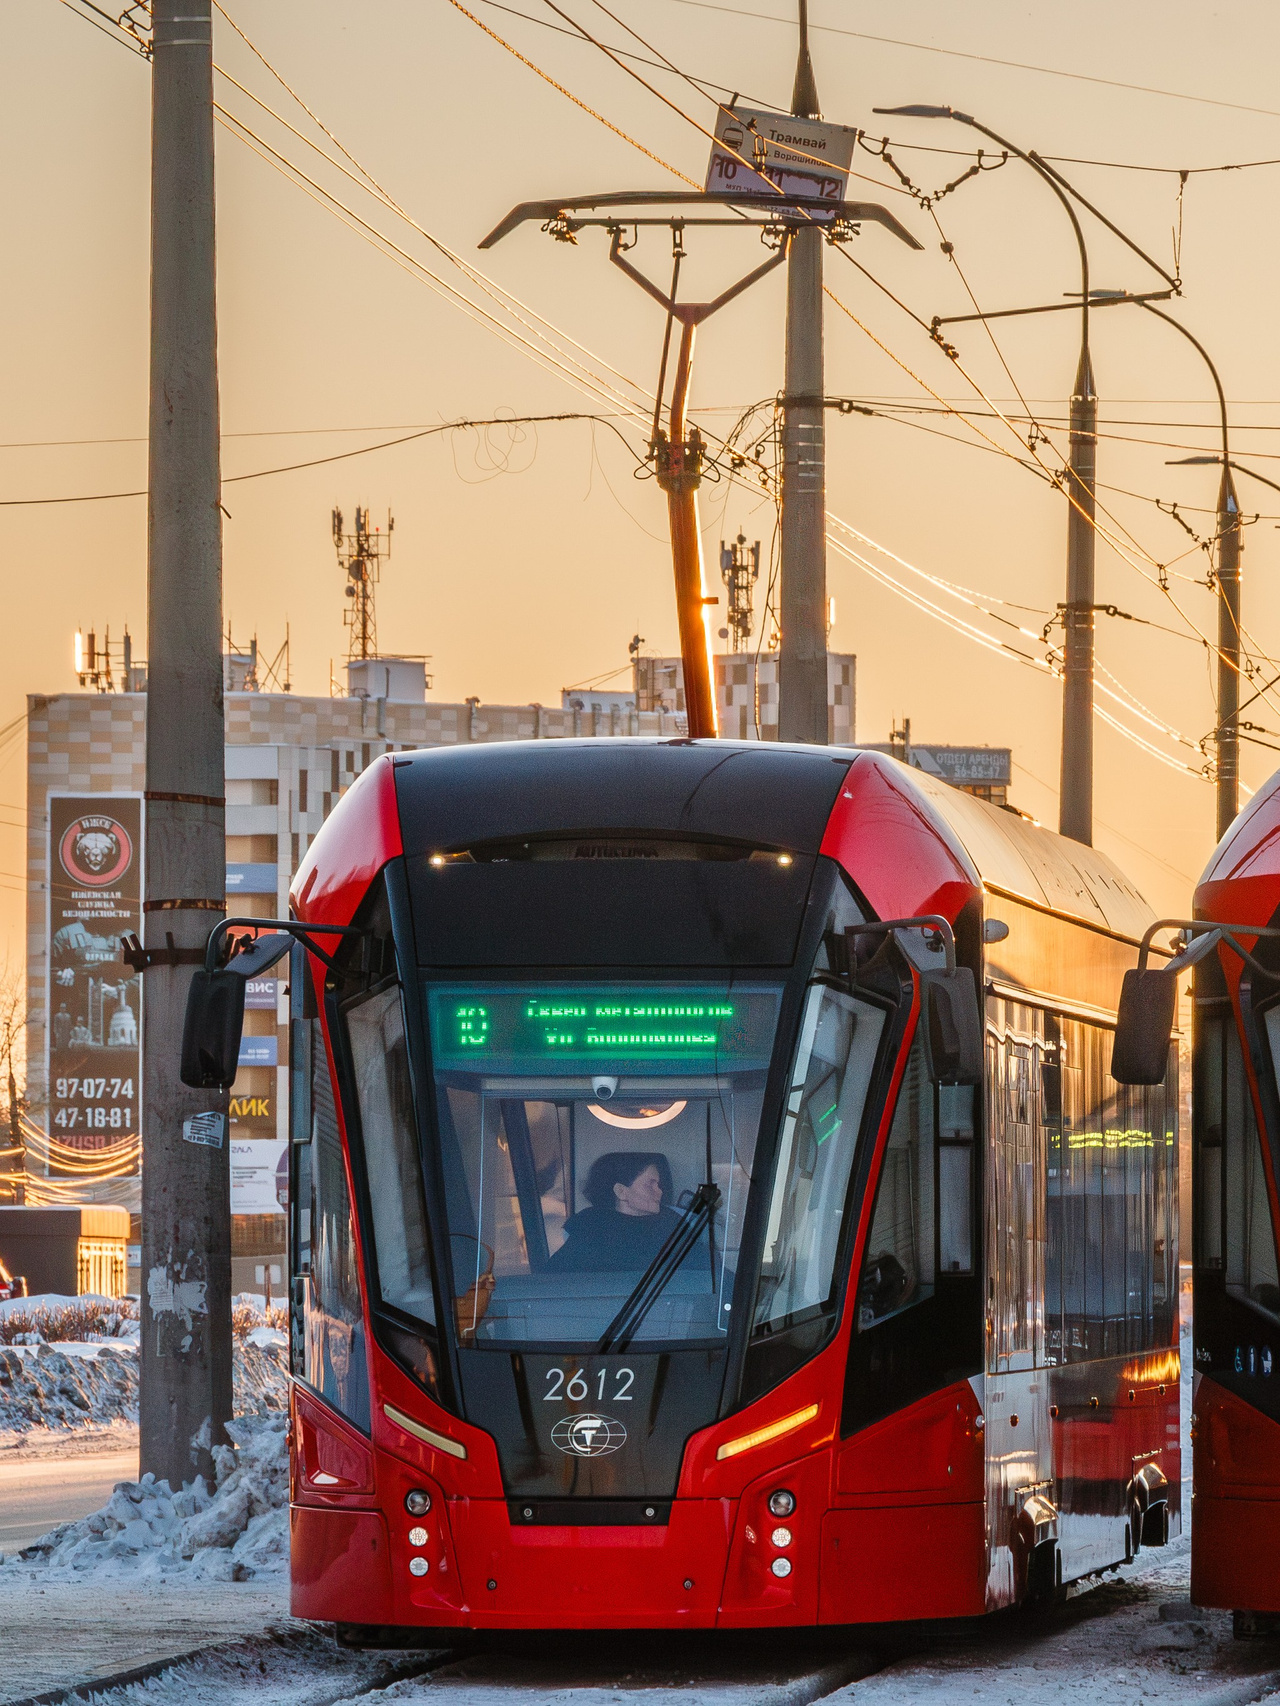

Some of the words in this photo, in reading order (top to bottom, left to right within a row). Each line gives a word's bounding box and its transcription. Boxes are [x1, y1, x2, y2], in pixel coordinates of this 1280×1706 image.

[769, 129, 827, 151] Трамвай
[715, 161, 737, 180] 10
[818, 180, 840, 199] 12
[56, 1077, 134, 1099] 97-07-74
[54, 1107, 131, 1128] 47-18-81
[542, 1367, 635, 1401] 2612
